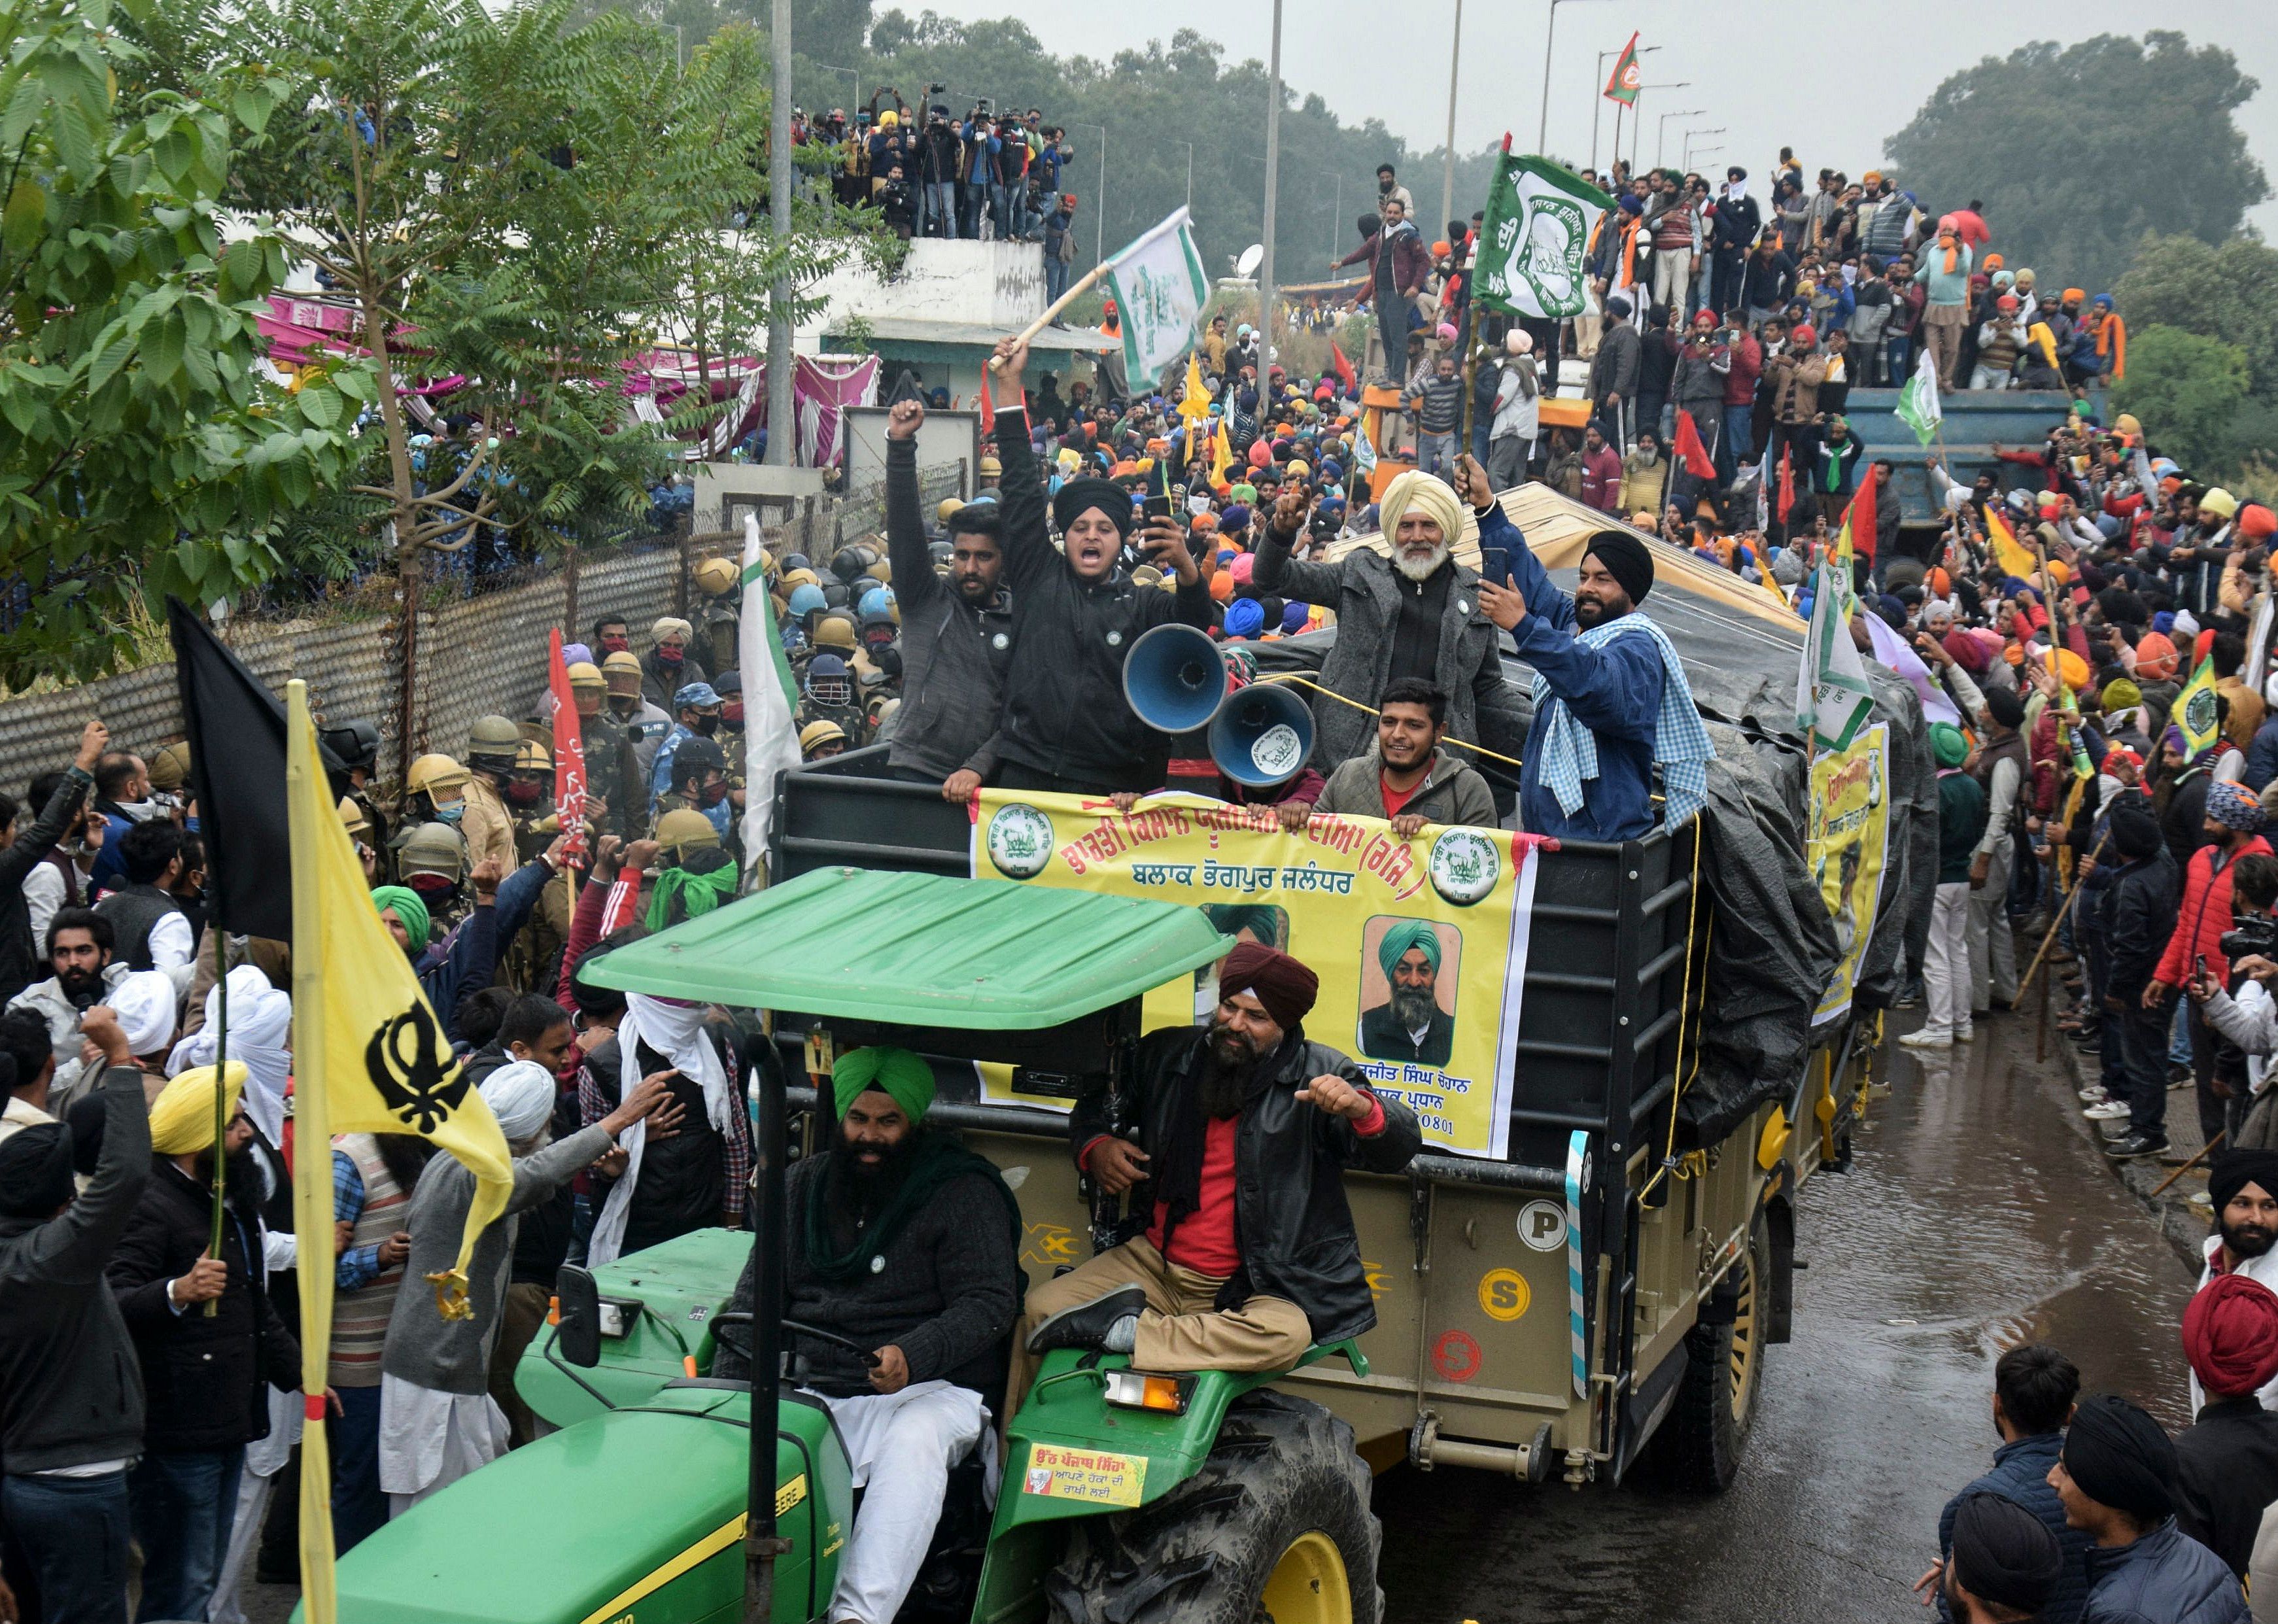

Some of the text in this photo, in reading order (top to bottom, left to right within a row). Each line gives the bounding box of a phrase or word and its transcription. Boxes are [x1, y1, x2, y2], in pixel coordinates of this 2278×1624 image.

[1131, 863, 1197, 886] ਬਲਾਕ
[1281, 861, 1355, 895] ਜਲੰਧਰ
[1404, 1063, 1434, 1085] ਸਿੰਘ
[1415, 1113, 1454, 1135] 0801
[1531, 1210, 1559, 1239] P
[1491, 1279, 1518, 1307] S
[1442, 1342, 1471, 1371] S
[775, 1487, 797, 1514] EERE
